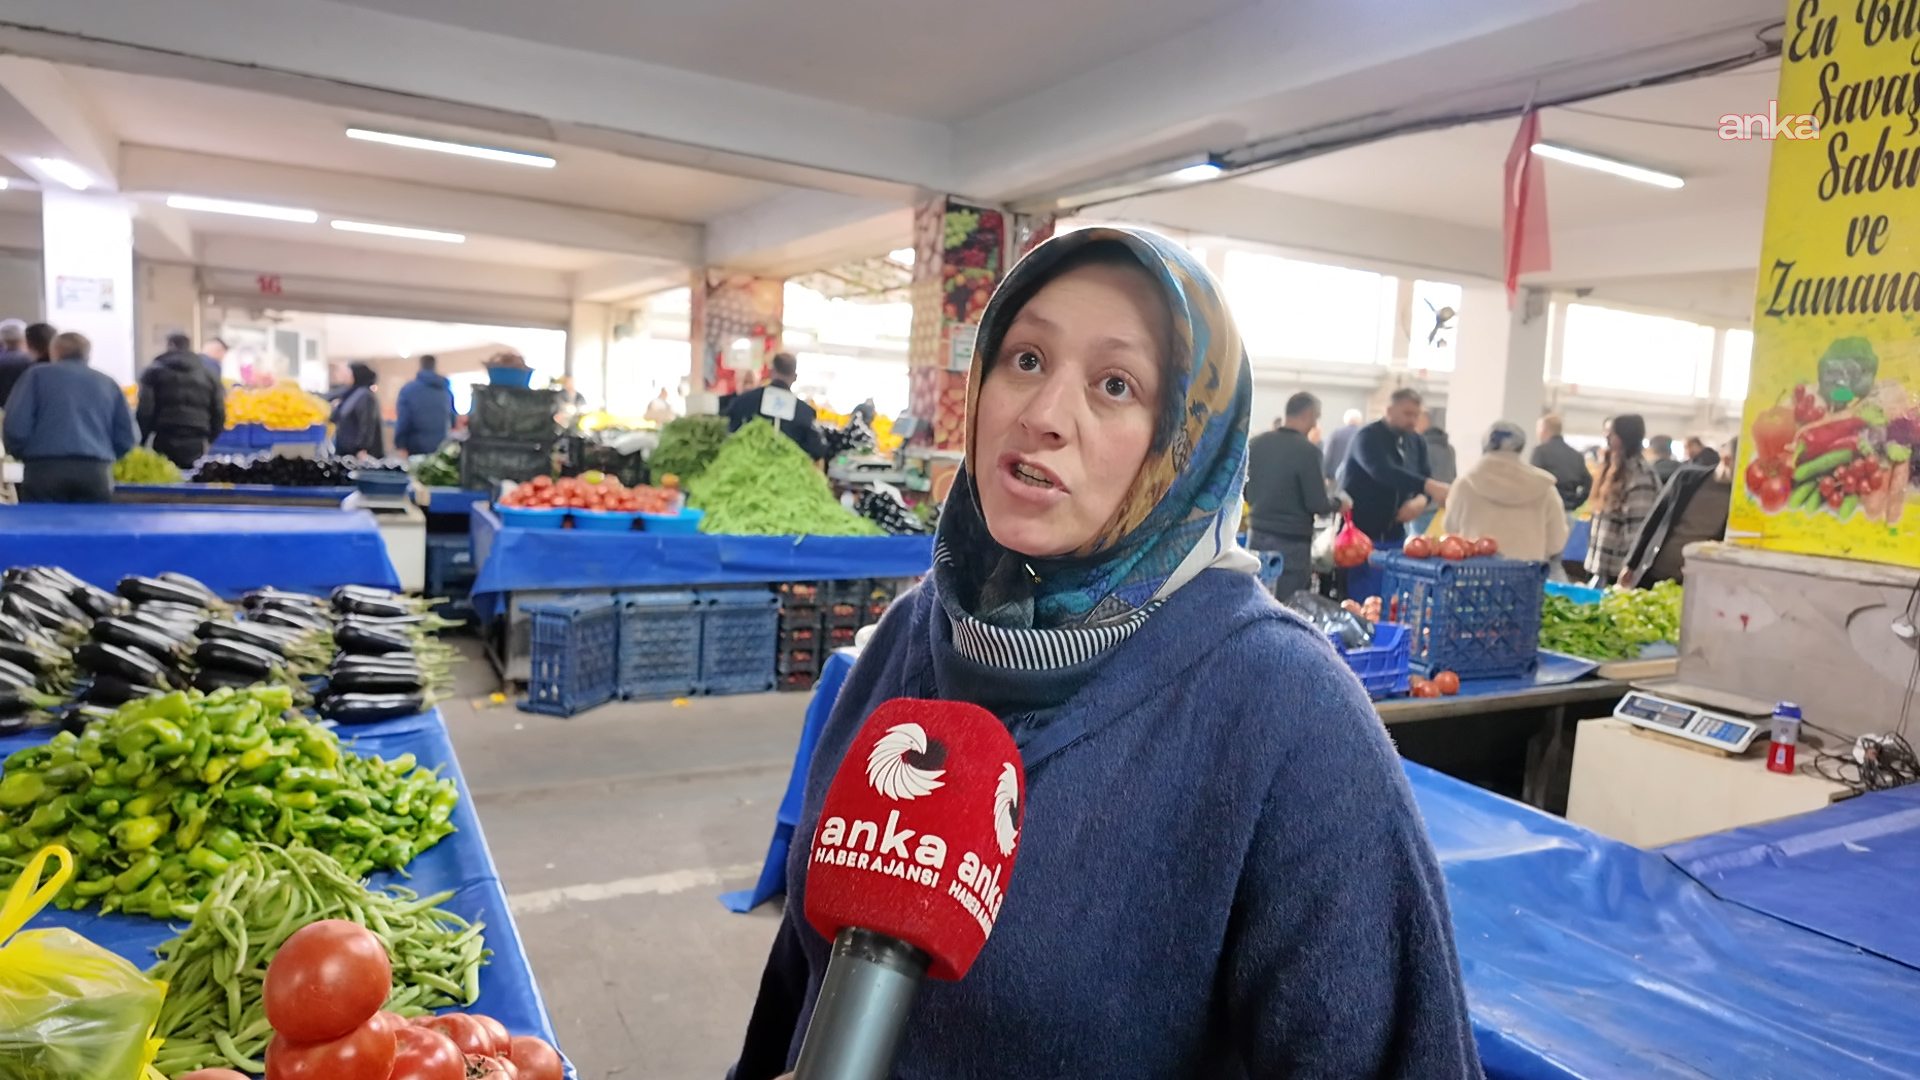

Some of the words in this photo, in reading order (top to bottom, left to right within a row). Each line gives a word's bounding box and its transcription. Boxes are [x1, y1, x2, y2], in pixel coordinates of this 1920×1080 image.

[1788, 0, 1839, 62] En
[1846, 214, 1889, 257] ve
[820, 809, 947, 869] anka
[815, 847, 870, 870] HABER
[869, 856, 940, 888] AJANSI
